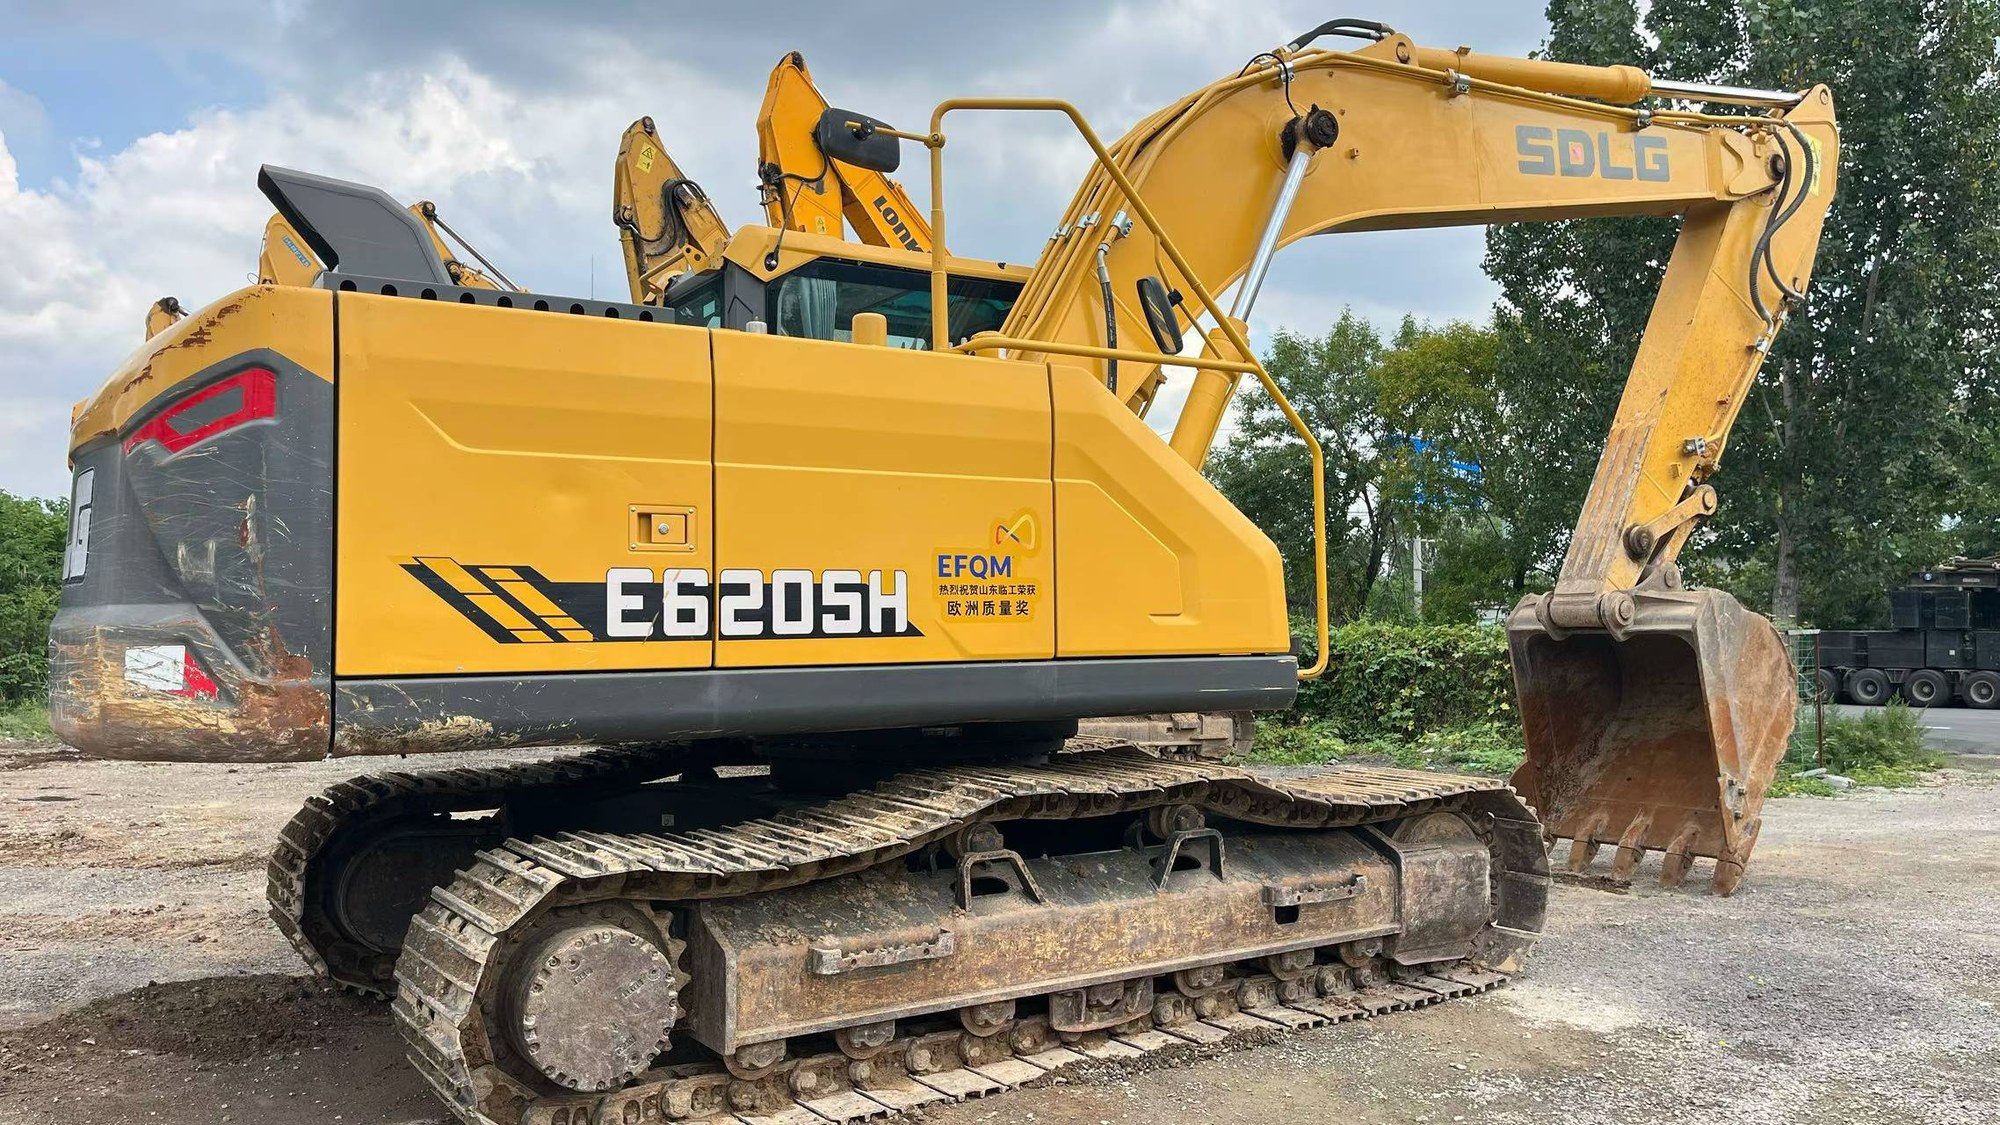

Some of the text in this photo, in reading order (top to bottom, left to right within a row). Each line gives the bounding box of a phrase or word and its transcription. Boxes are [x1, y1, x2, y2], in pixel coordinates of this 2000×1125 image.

[1515, 124, 1670, 182] SDLG
[938, 554, 1012, 580] EFQM
[606, 567, 908, 637] E6205H
[938, 584, 1037, 596] 热烈祝贺山东临工荣获
[947, 599, 1030, 617] 欧洲质量奖
